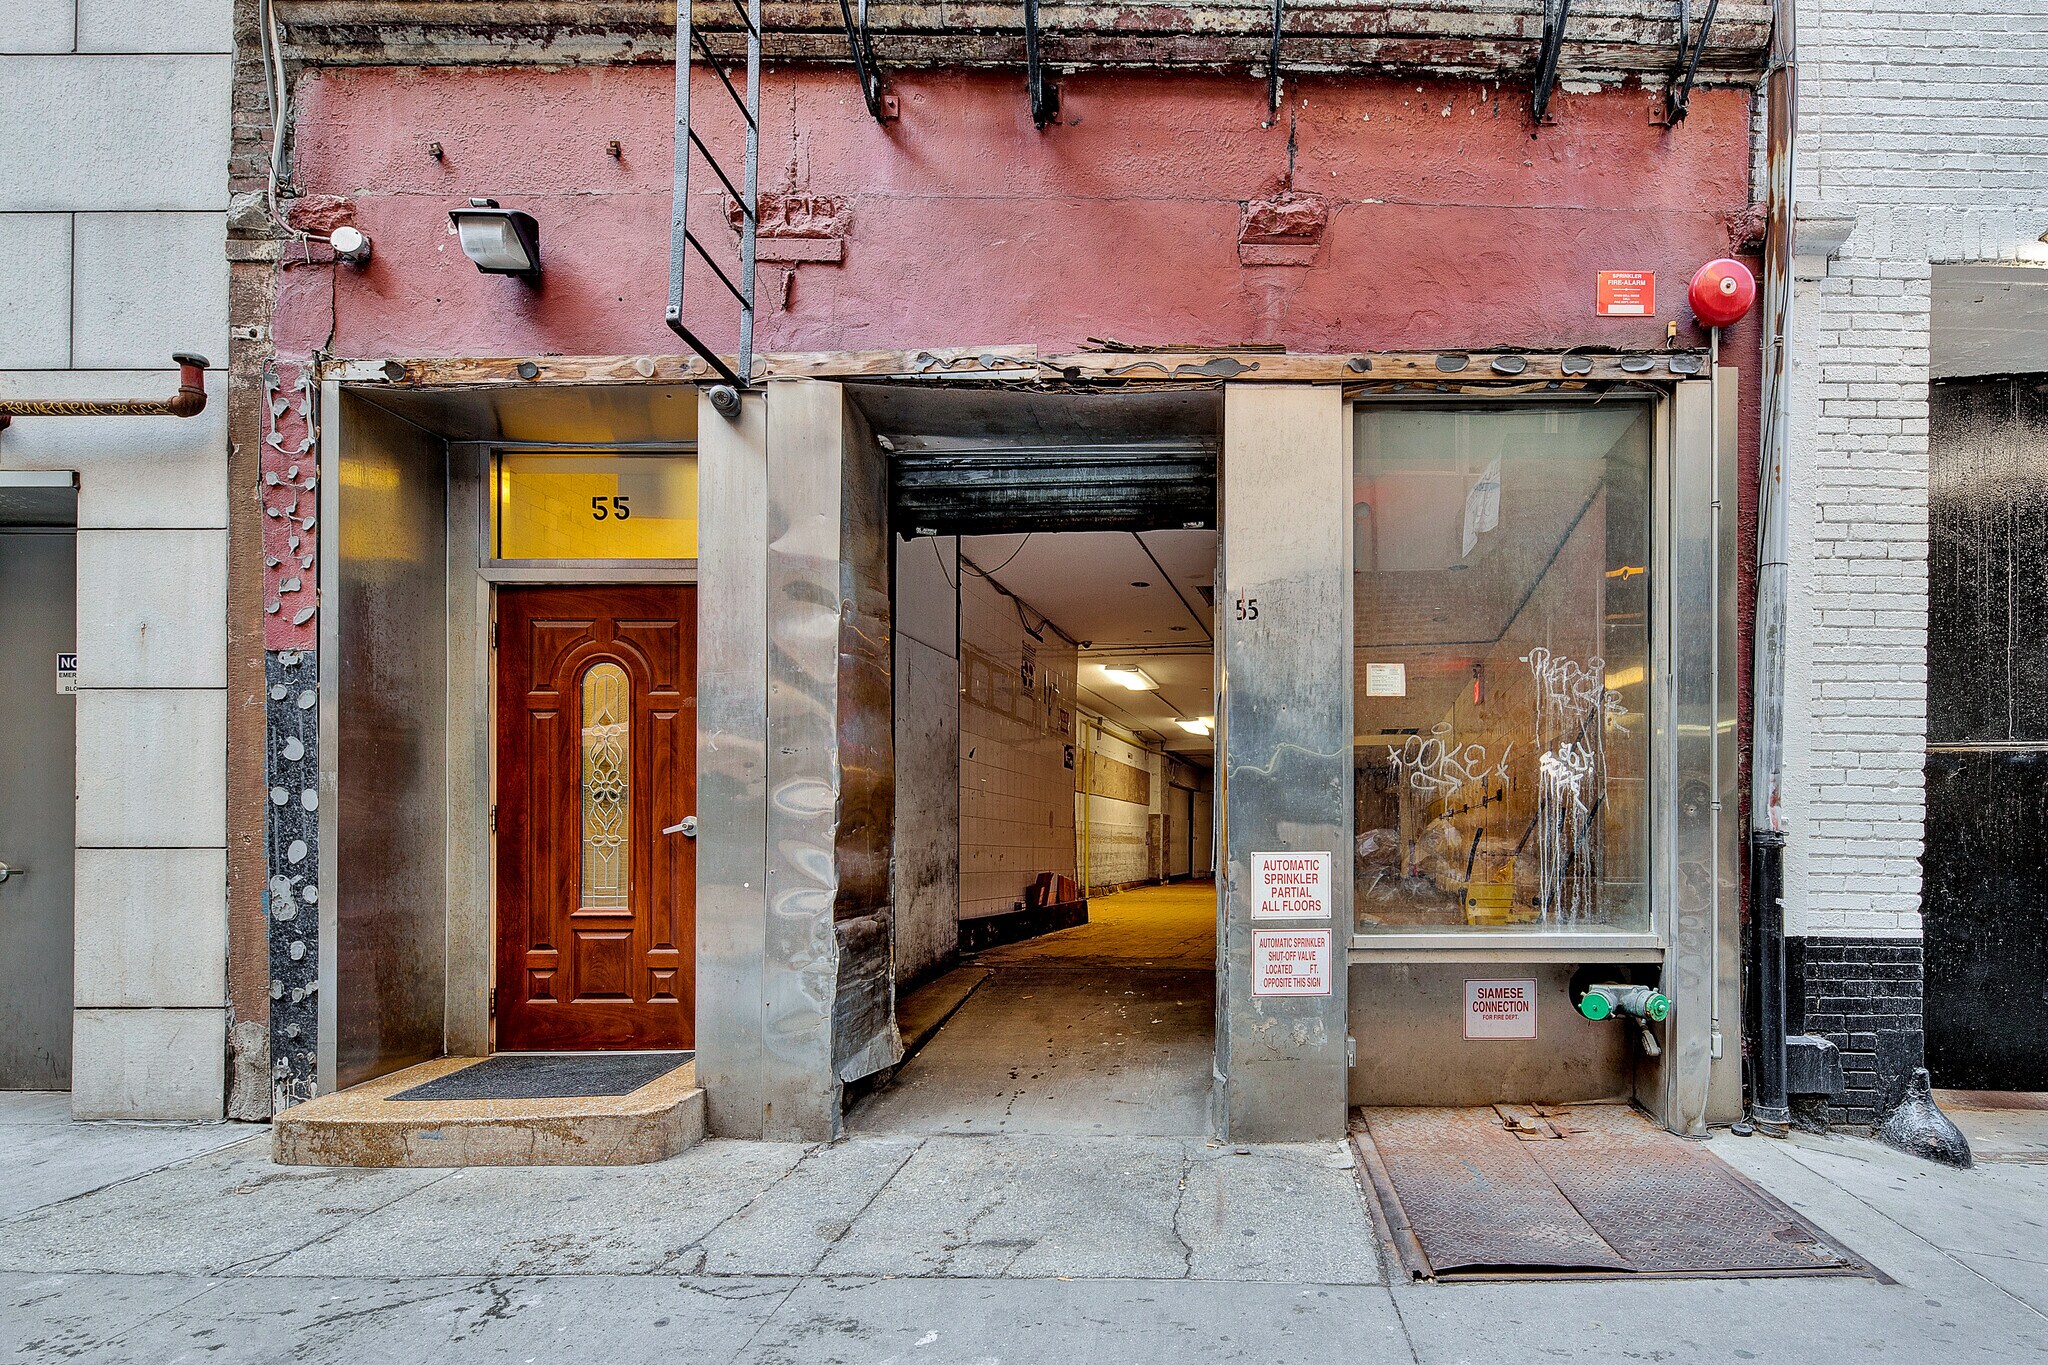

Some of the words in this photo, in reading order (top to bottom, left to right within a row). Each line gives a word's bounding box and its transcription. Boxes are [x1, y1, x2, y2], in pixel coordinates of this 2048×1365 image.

[592, 496, 630, 521] 55
[1236, 599, 1259, 621] 55
[1263, 859, 1320, 871] AUTOMATIC
[1264, 873, 1319, 885] SPRINKLER
[1271, 886, 1312, 898] PARTIAL
[1261, 900, 1280, 912] ALL
[1282, 899, 1322, 911] FLOORS
[1259, 937, 1293, 949] AUTOMATIC
[1293, 937, 1326, 948] SPRINKLER
[1268, 951, 1297, 961] SHUT-OFF
[1297, 950, 1316, 961] VALVE
[1265, 964, 1293, 974] LOCATED
[1263, 977, 1292, 988] OPPOSITE
[1293, 977, 1306, 988] THIS
[1306, 977, 1321, 988] SIGN
[1477, 987, 1524, 998] SIAMESE
[1472, 1000, 1529, 1012] CONNECTION
